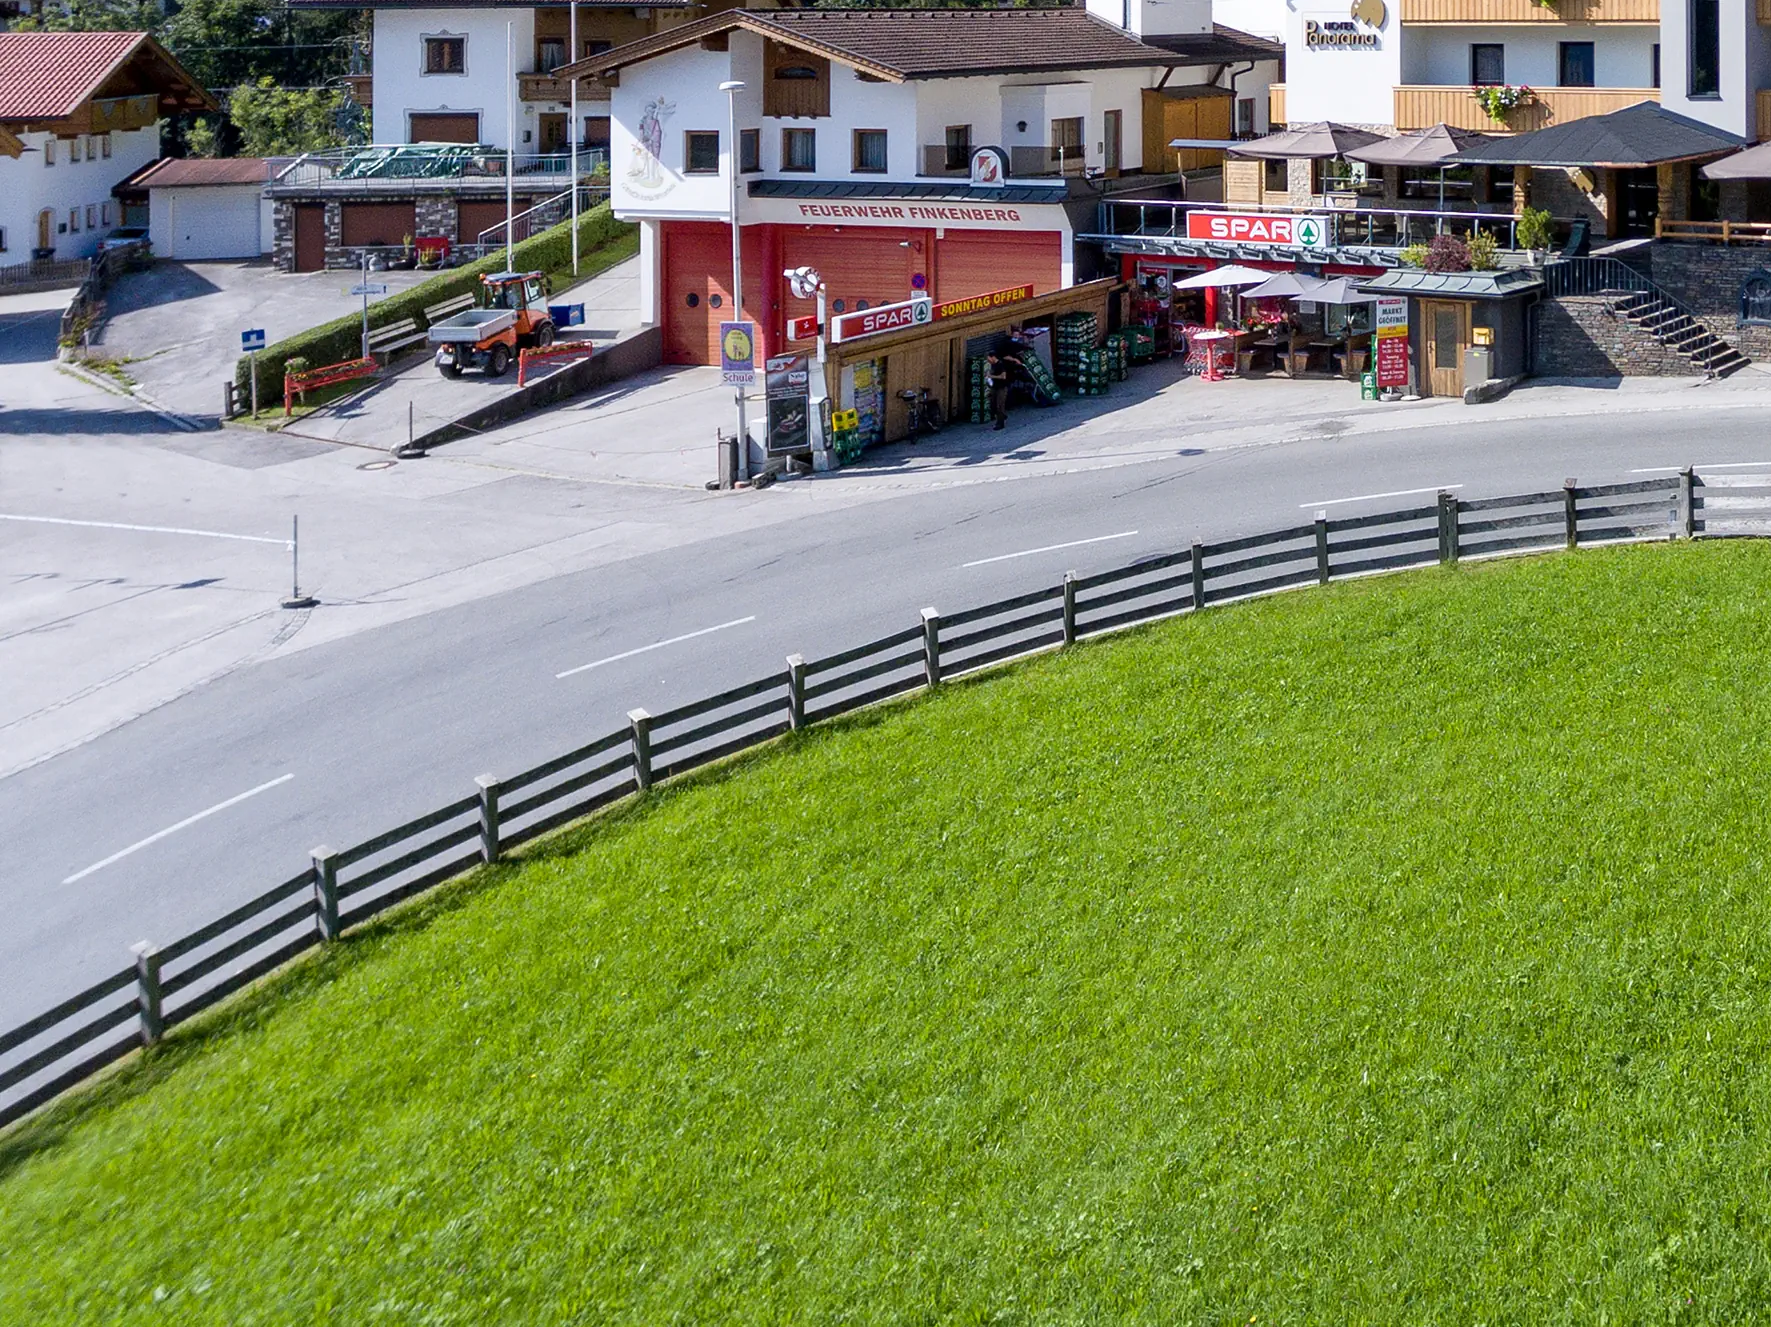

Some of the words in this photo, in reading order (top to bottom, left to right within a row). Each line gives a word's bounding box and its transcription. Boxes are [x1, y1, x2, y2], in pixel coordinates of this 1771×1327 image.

[1305, 20, 1376, 45] Panorama
[1324, 21, 1355, 31] HOTEL
[798, 204, 904, 218] FEUERWEHR
[909, 207, 1020, 221] FINKENBERG
[1210, 218, 1291, 240] SPAR
[941, 296, 990, 317] SONNTAG
[993, 287, 1025, 304] OFFEN
[863, 307, 912, 331] SPAR
[723, 373, 754, 382] Schule
